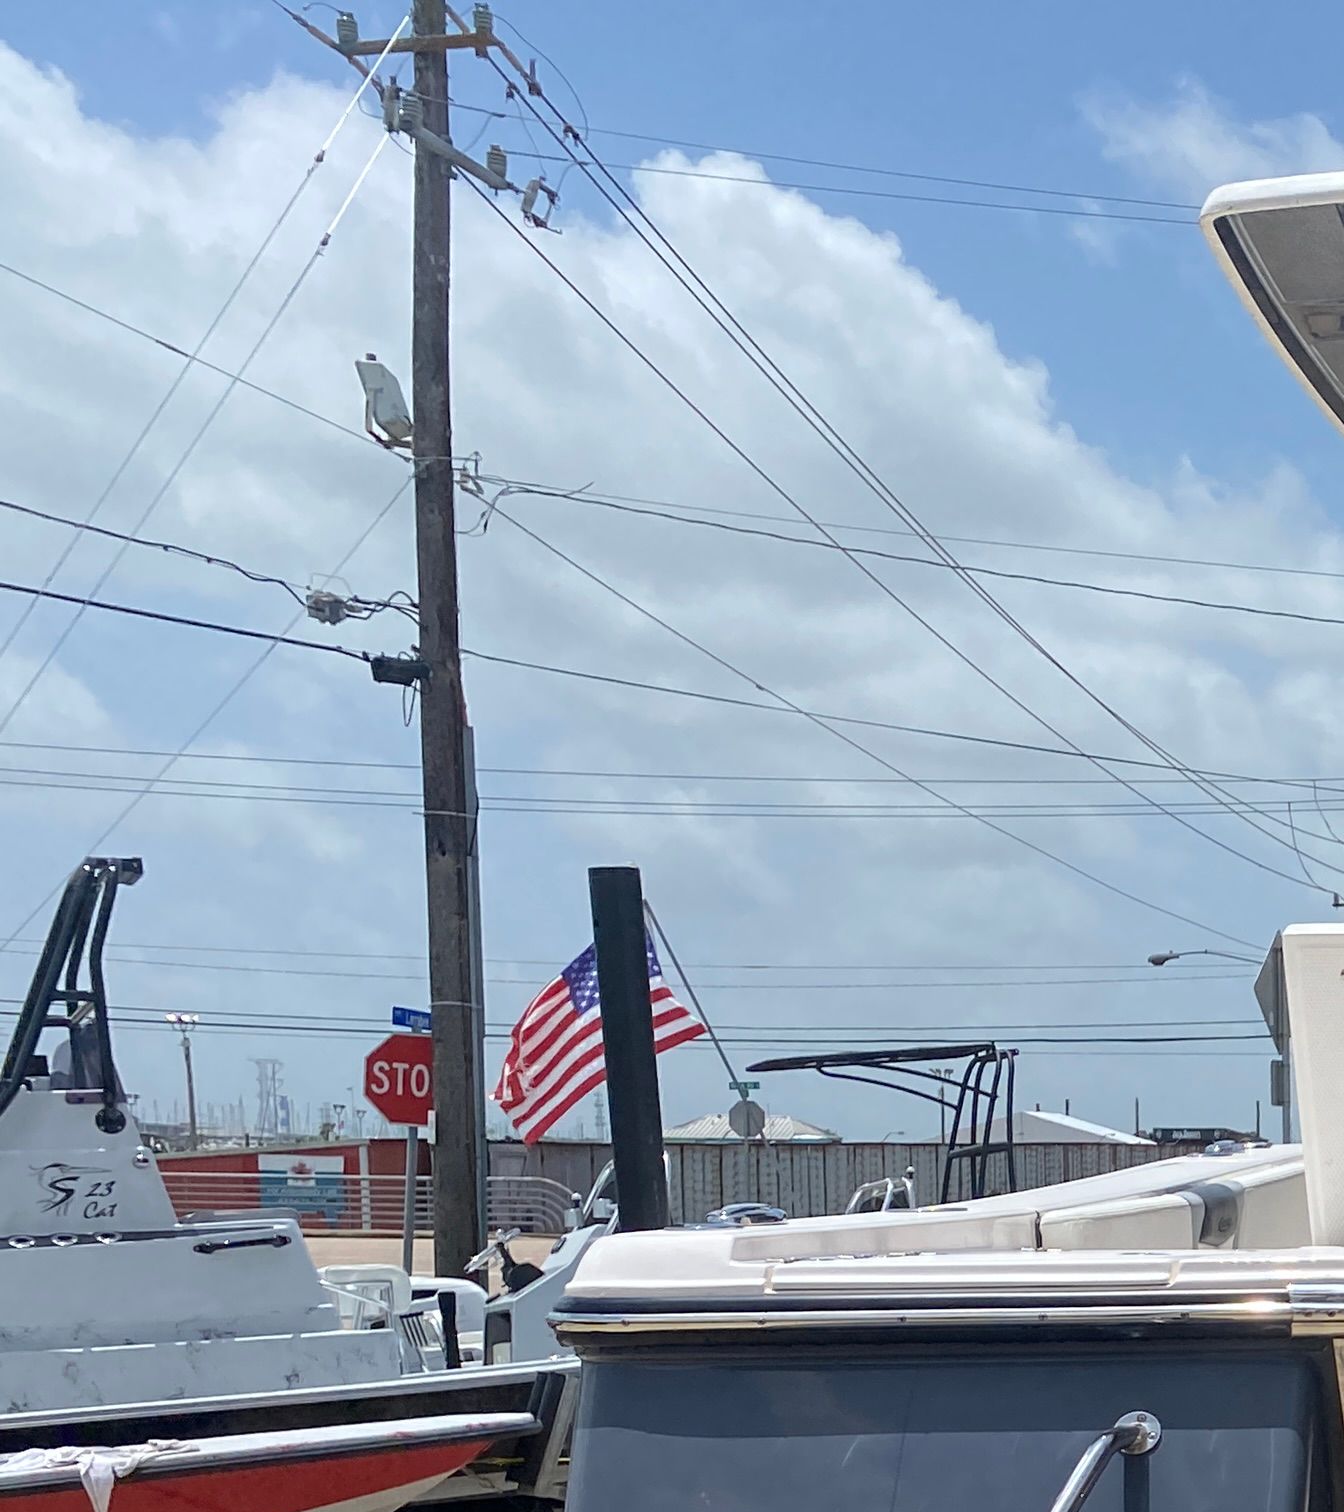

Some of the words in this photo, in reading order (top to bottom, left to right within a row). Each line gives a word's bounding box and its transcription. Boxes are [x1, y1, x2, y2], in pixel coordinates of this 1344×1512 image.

[370, 1060, 430, 1098] STO
[84, 1181, 116, 1198] 23
[83, 1201, 118, 1219] Cat
